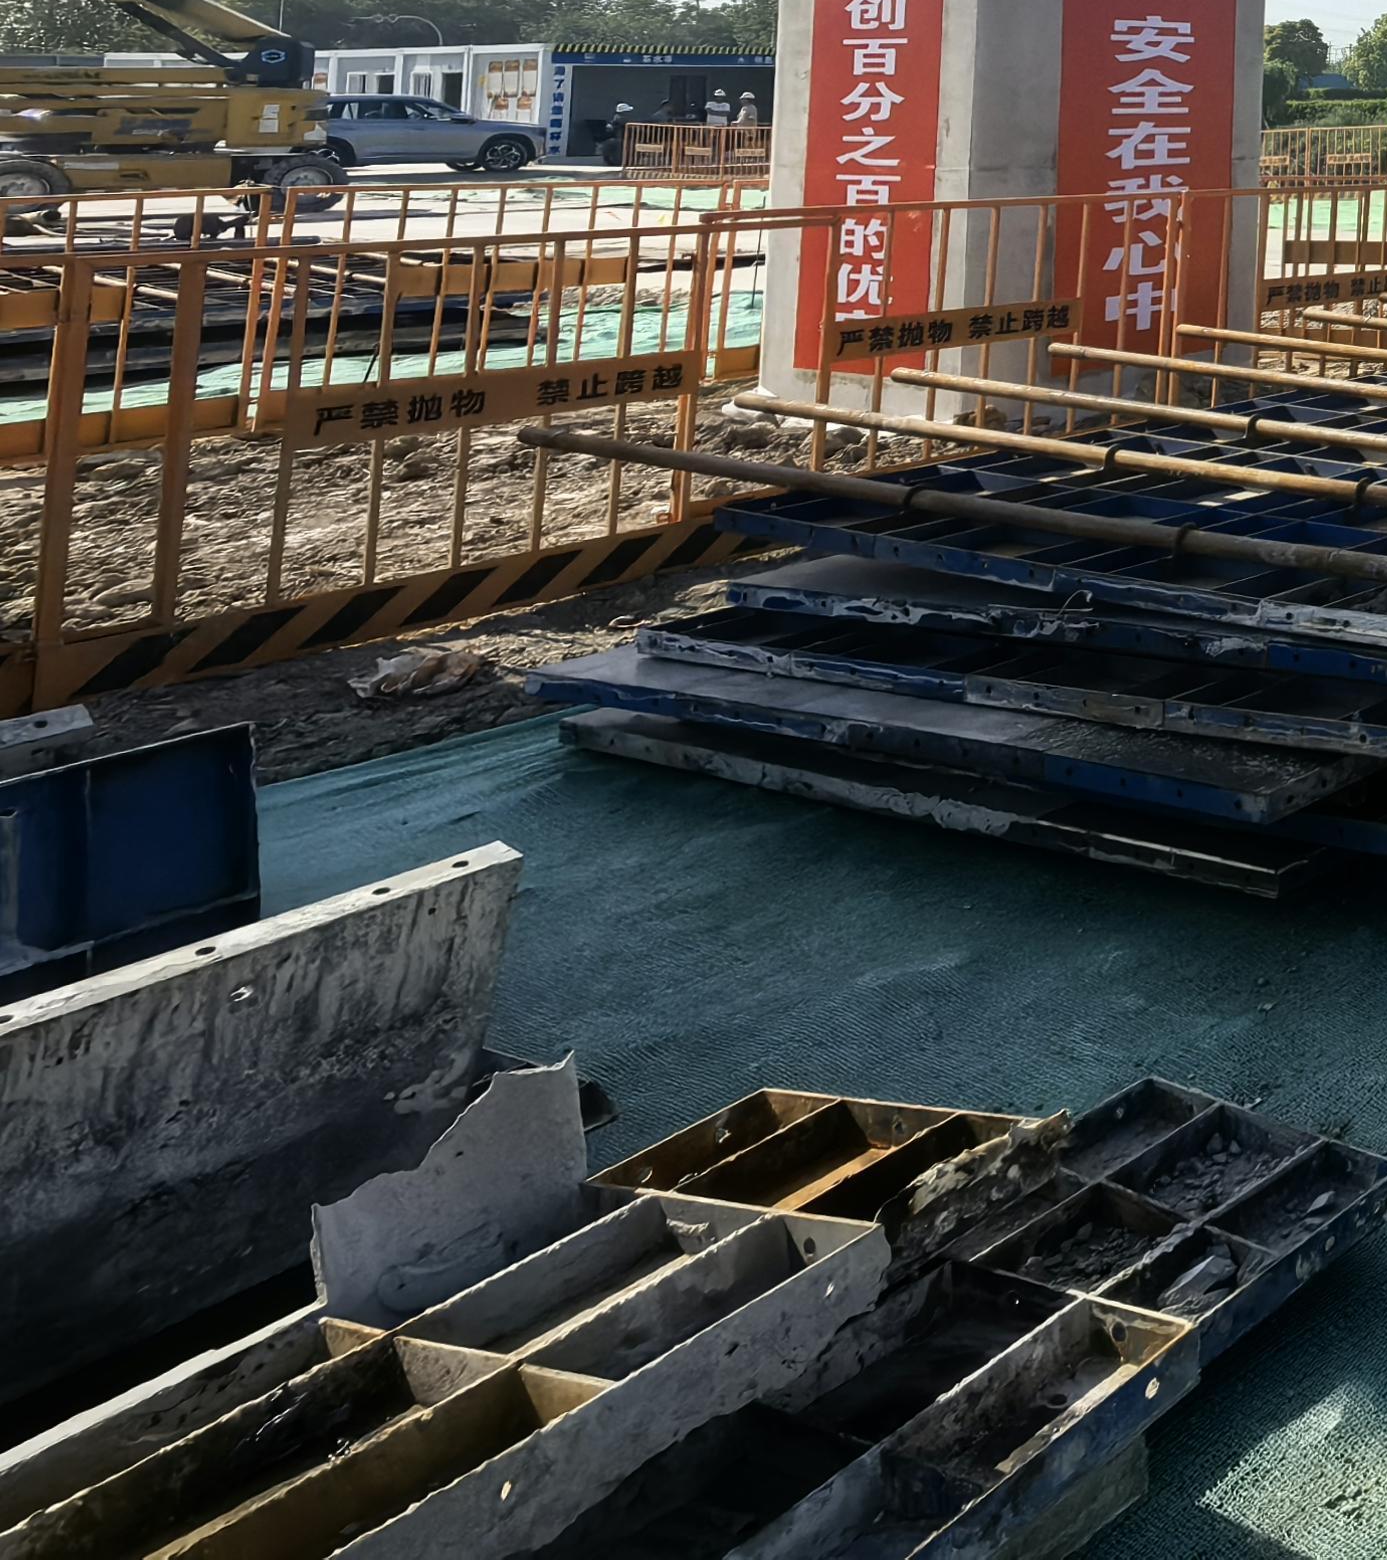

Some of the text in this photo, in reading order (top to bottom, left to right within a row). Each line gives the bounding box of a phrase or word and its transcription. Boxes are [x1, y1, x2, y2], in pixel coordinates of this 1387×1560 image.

[1103, 15, 1195, 330] 安全在我心中
[836, 305, 1070, 357] 严禁抛物 禁止跨越
[313, 363, 683, 436] 严禁抛物 禁止跨越
